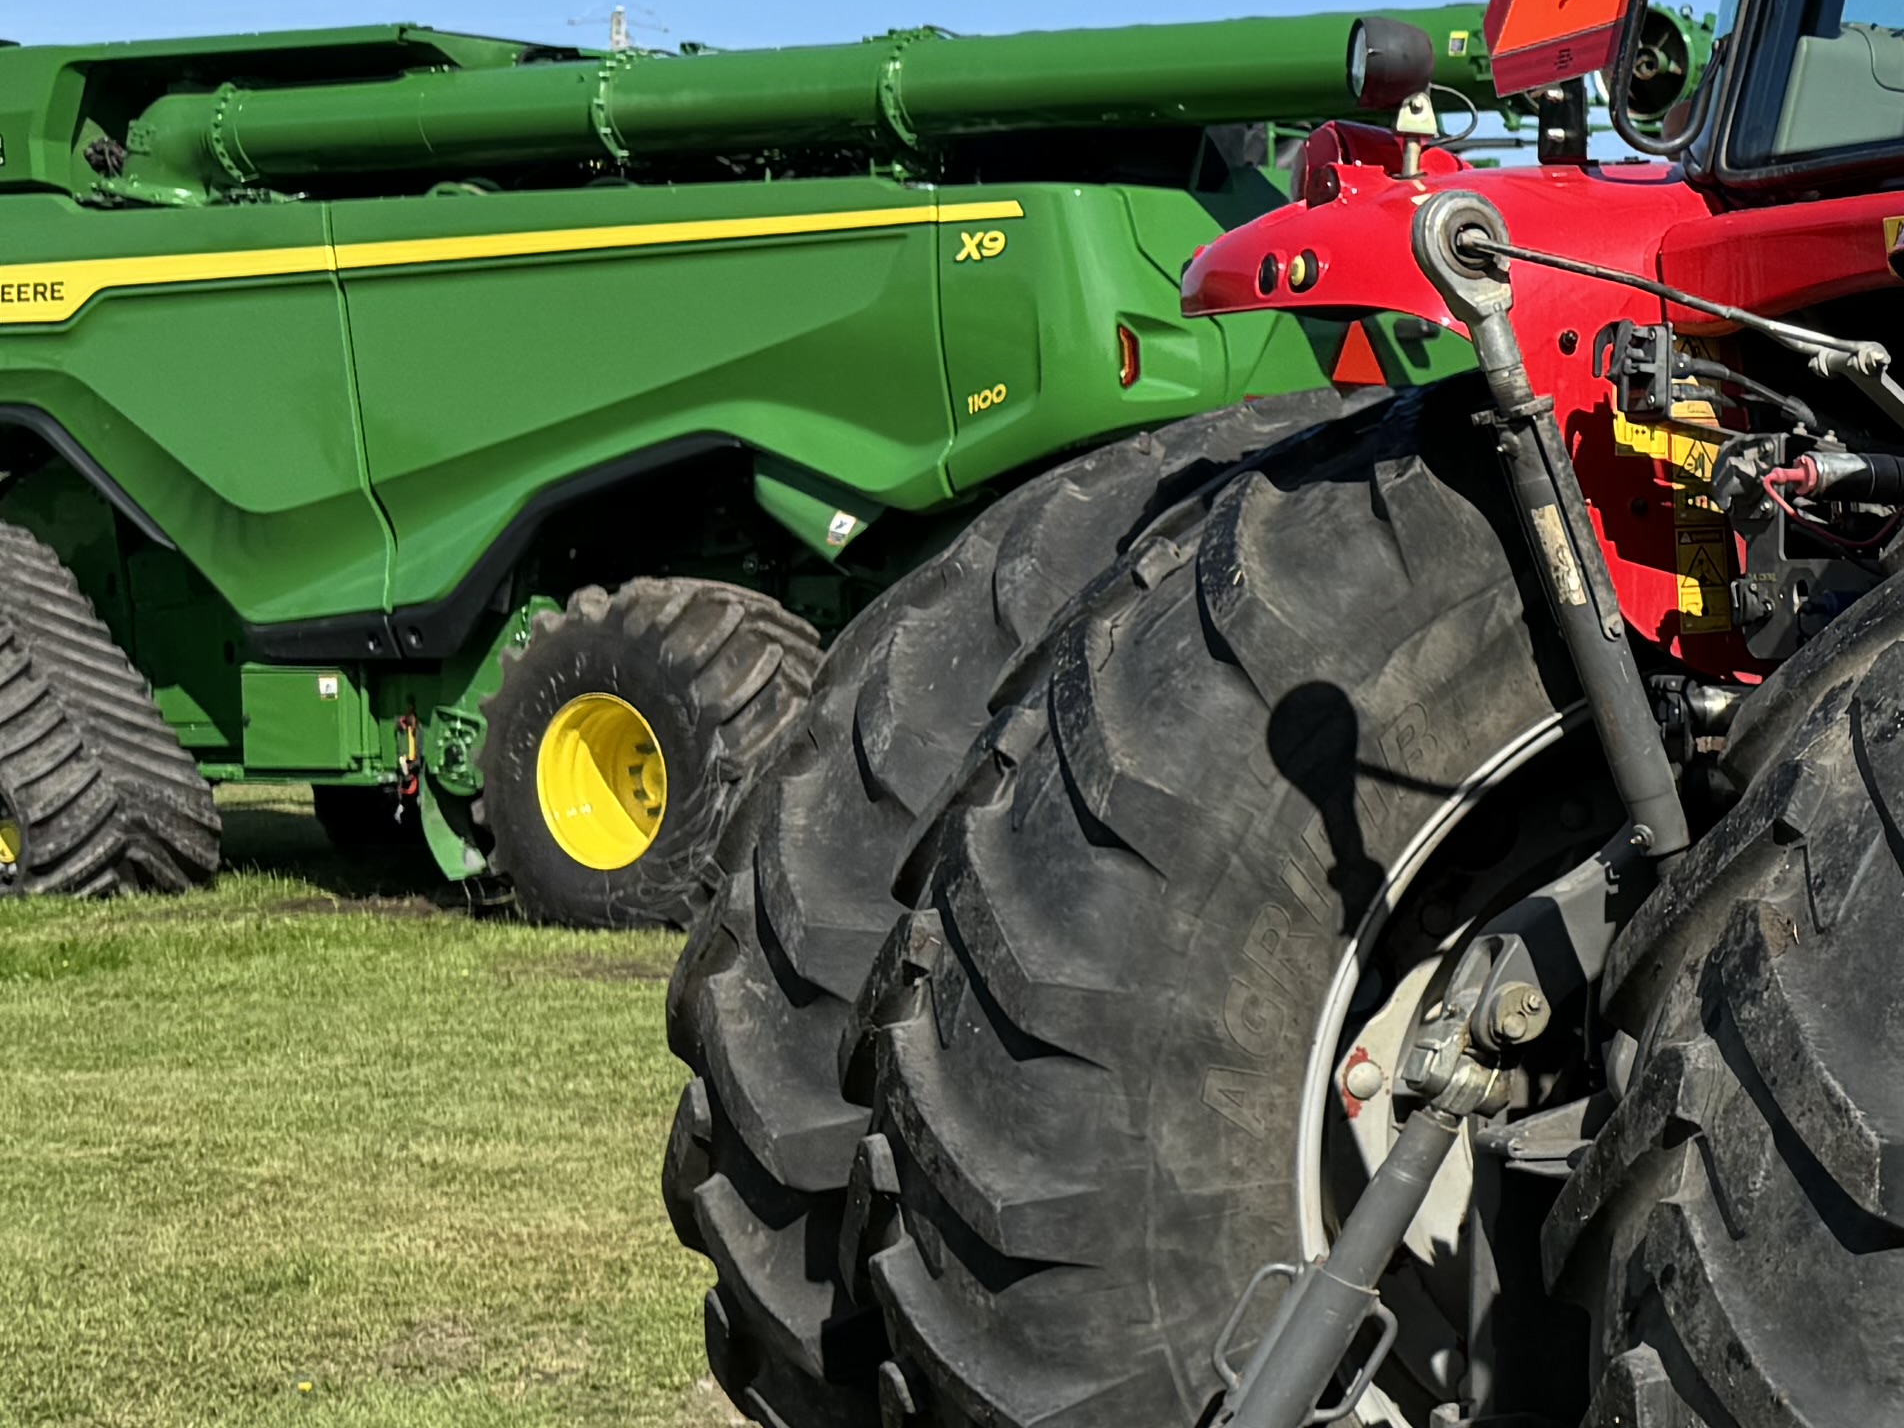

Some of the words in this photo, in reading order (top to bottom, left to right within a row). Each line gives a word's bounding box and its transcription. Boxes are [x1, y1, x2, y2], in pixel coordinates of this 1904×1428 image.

[955, 230, 1006, 262] X9
[0, 280, 65, 303] EERE
[968, 383, 1008, 415] 1100
